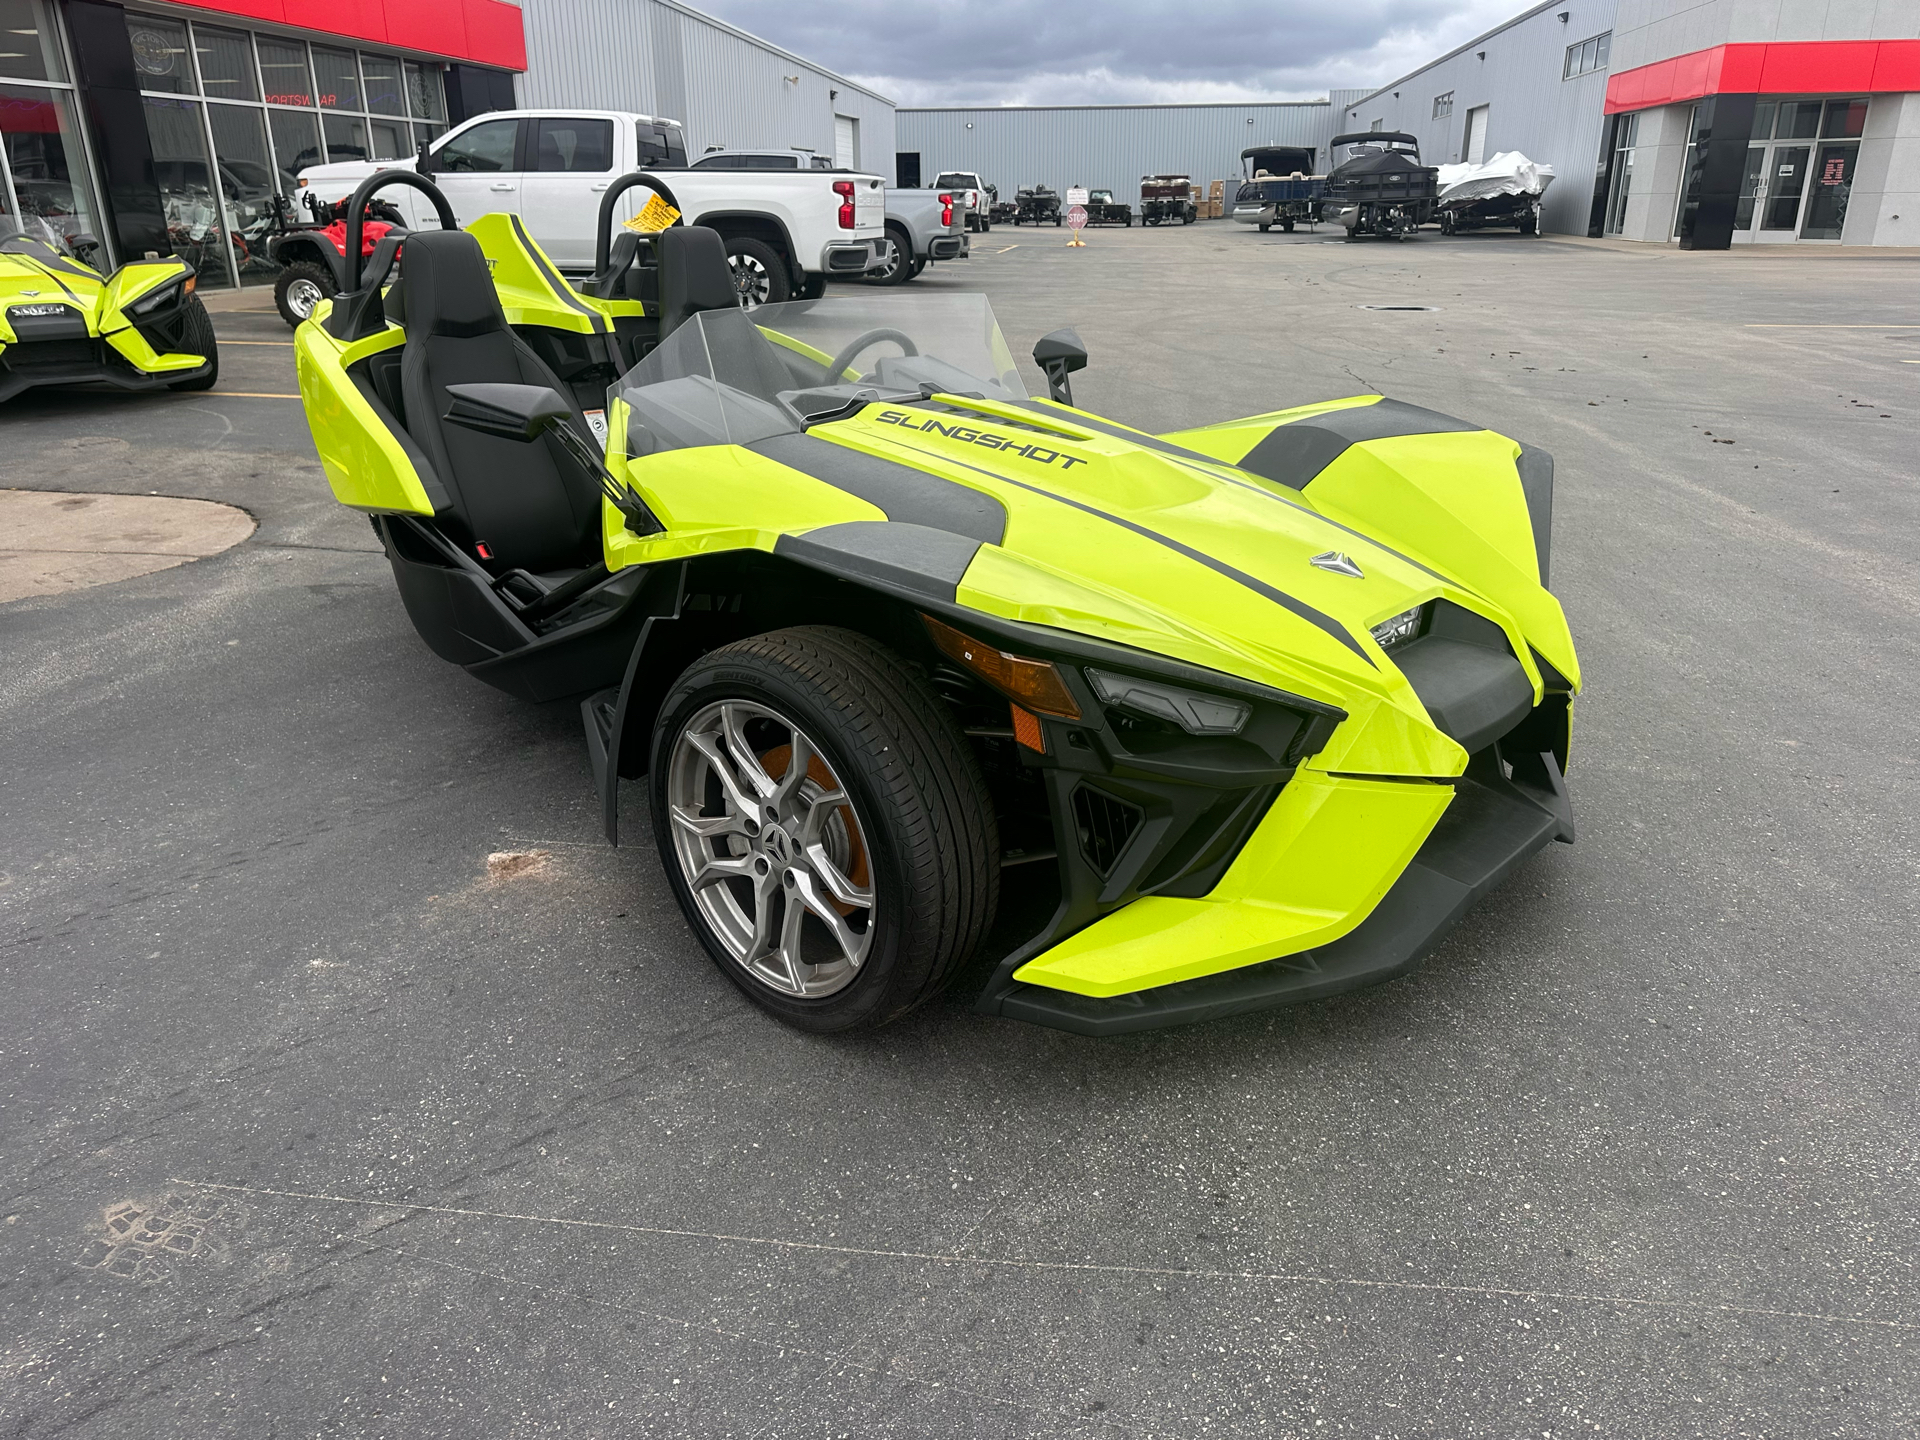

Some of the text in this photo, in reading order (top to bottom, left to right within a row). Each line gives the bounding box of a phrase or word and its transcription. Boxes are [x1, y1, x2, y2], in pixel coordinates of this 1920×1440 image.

[1068, 213, 1086, 223] STOP
[875, 410, 1088, 470] SLINGSHOT
[713, 671, 767, 686] SENTURY
